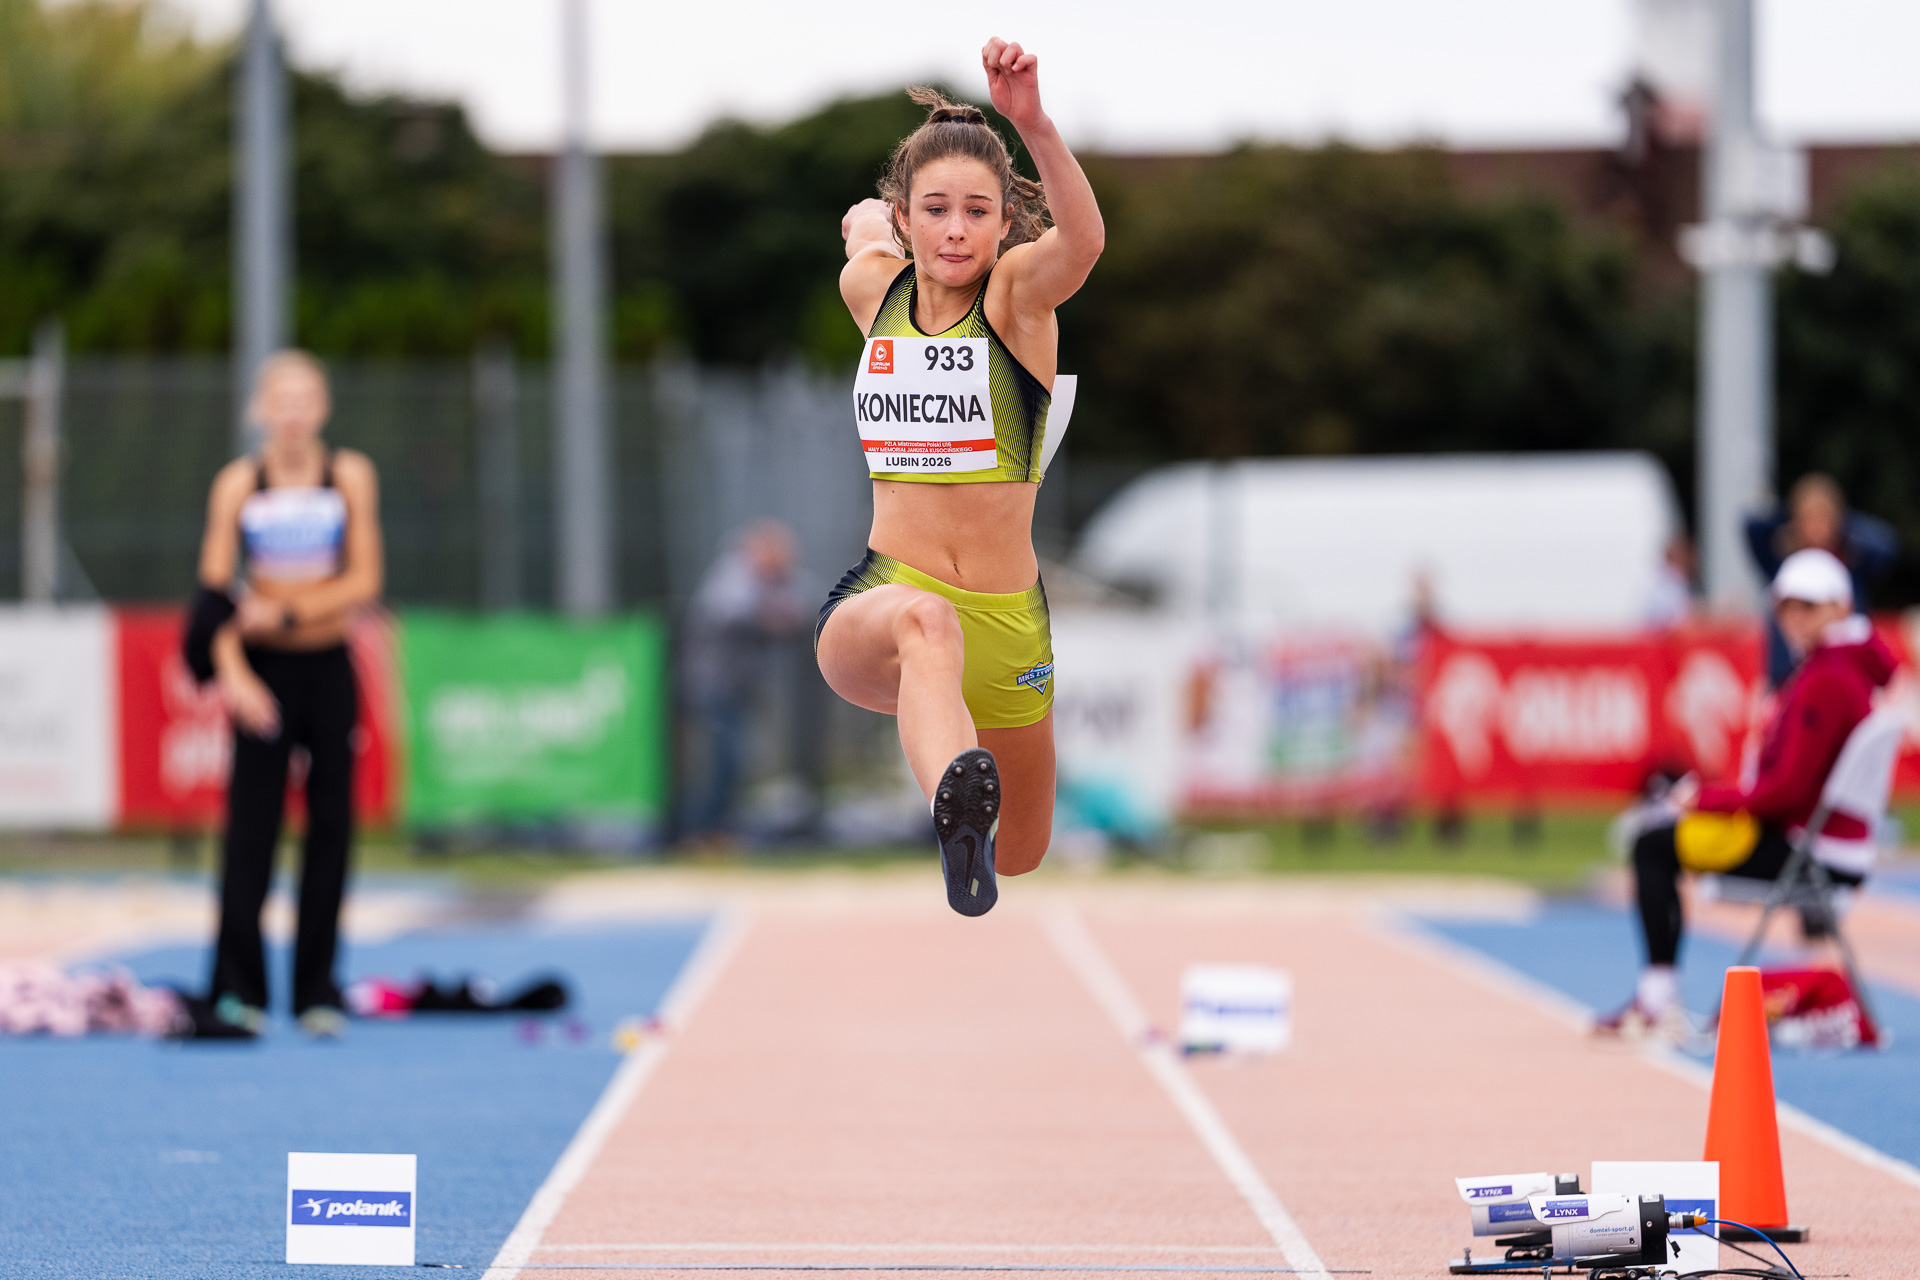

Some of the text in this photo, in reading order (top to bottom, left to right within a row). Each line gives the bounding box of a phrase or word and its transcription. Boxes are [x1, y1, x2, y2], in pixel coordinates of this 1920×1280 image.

[925, 345, 974, 371] 933
[858, 393, 986, 423] KONIECZNA
[885, 456, 952, 467] LUBIN 2026
[1017, 672, 1035, 684] MKS
[1479, 1188, 1503, 1197] LYNX
[325, 1199, 404, 1219] polanik
[1554, 1208, 1578, 1217] LYNX
[1589, 1225, 1635, 1234] domtel-sport.pl
